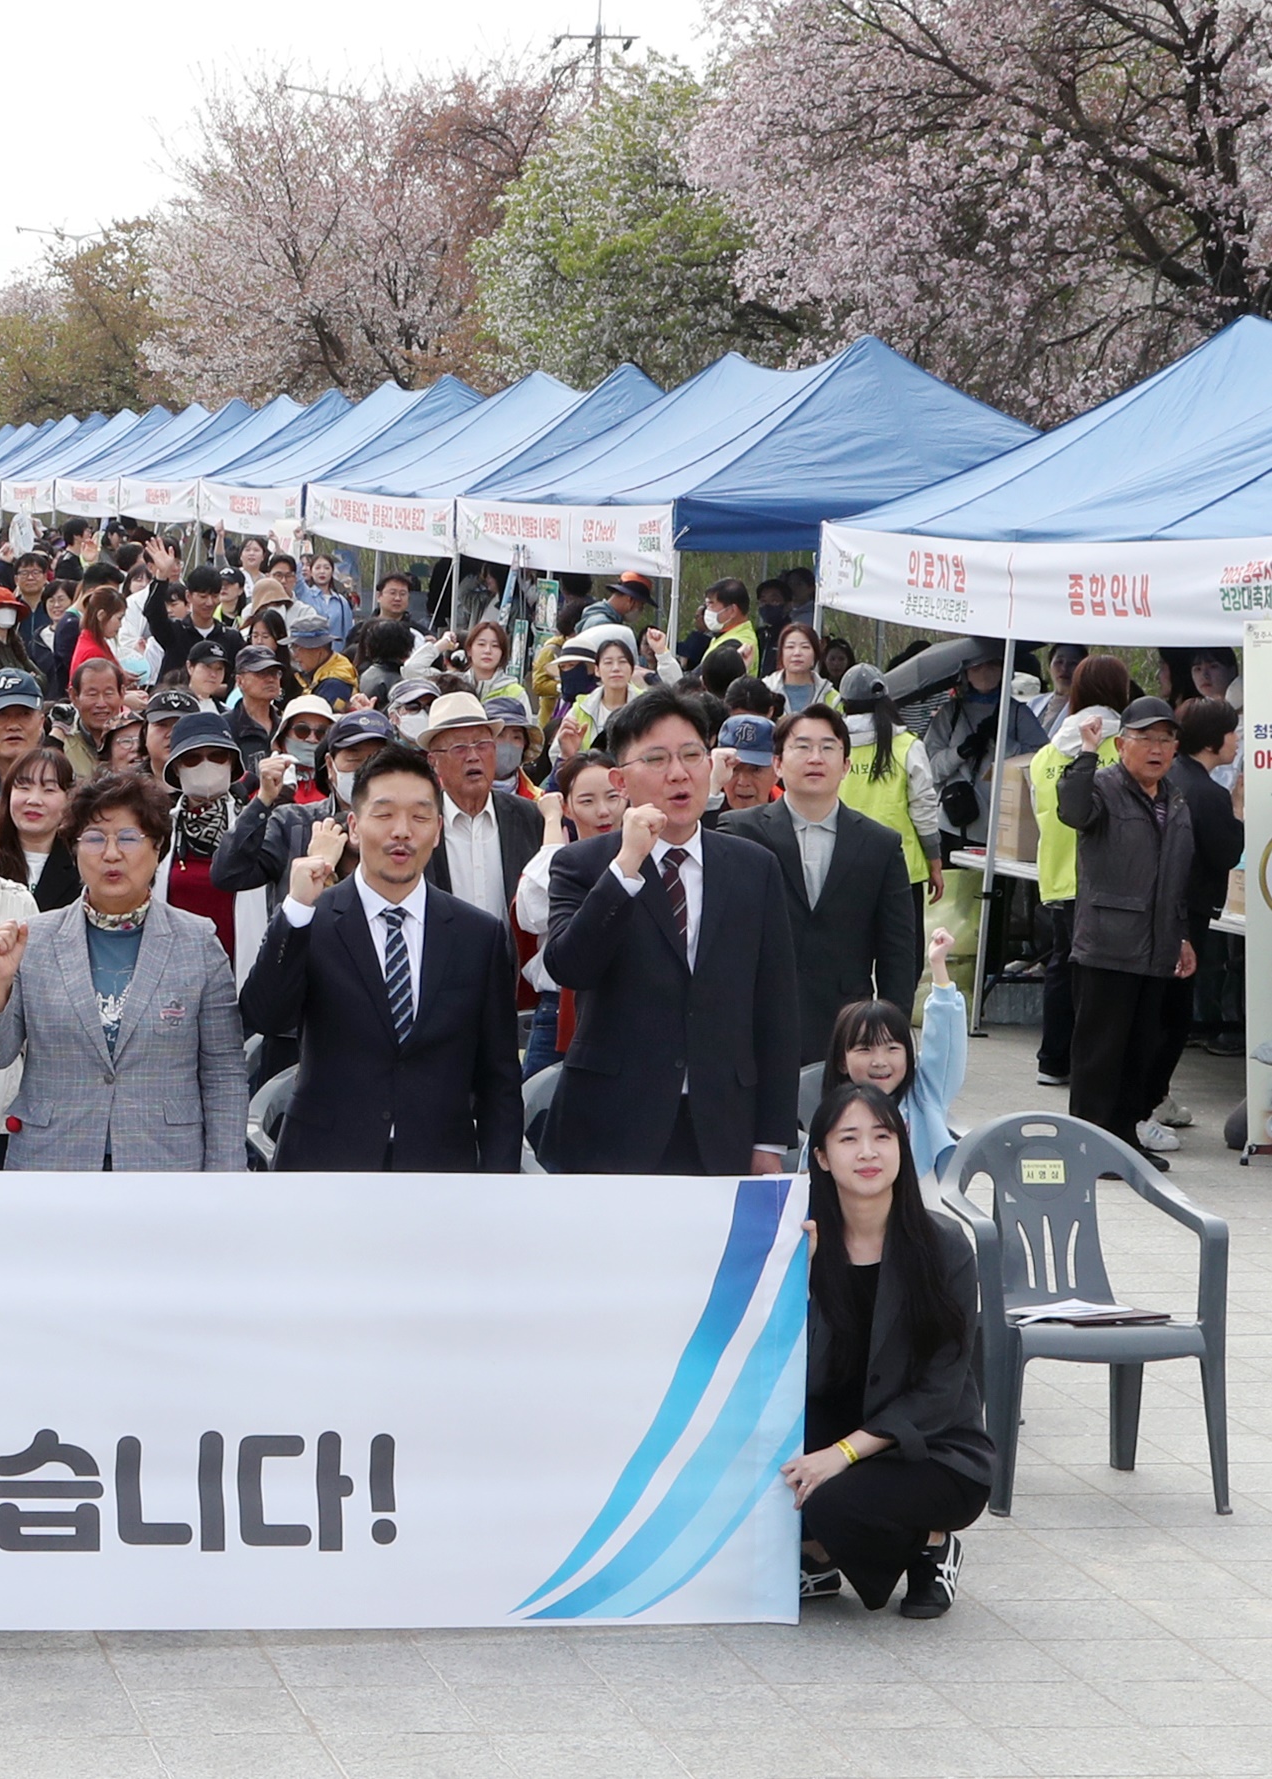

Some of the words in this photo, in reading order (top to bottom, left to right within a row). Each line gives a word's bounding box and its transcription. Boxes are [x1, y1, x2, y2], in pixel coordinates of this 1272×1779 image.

[907, 550, 966, 594] 의료지원
[1220, 566, 1244, 584] 2025
[1067, 573, 1152, 619] 종합안내
